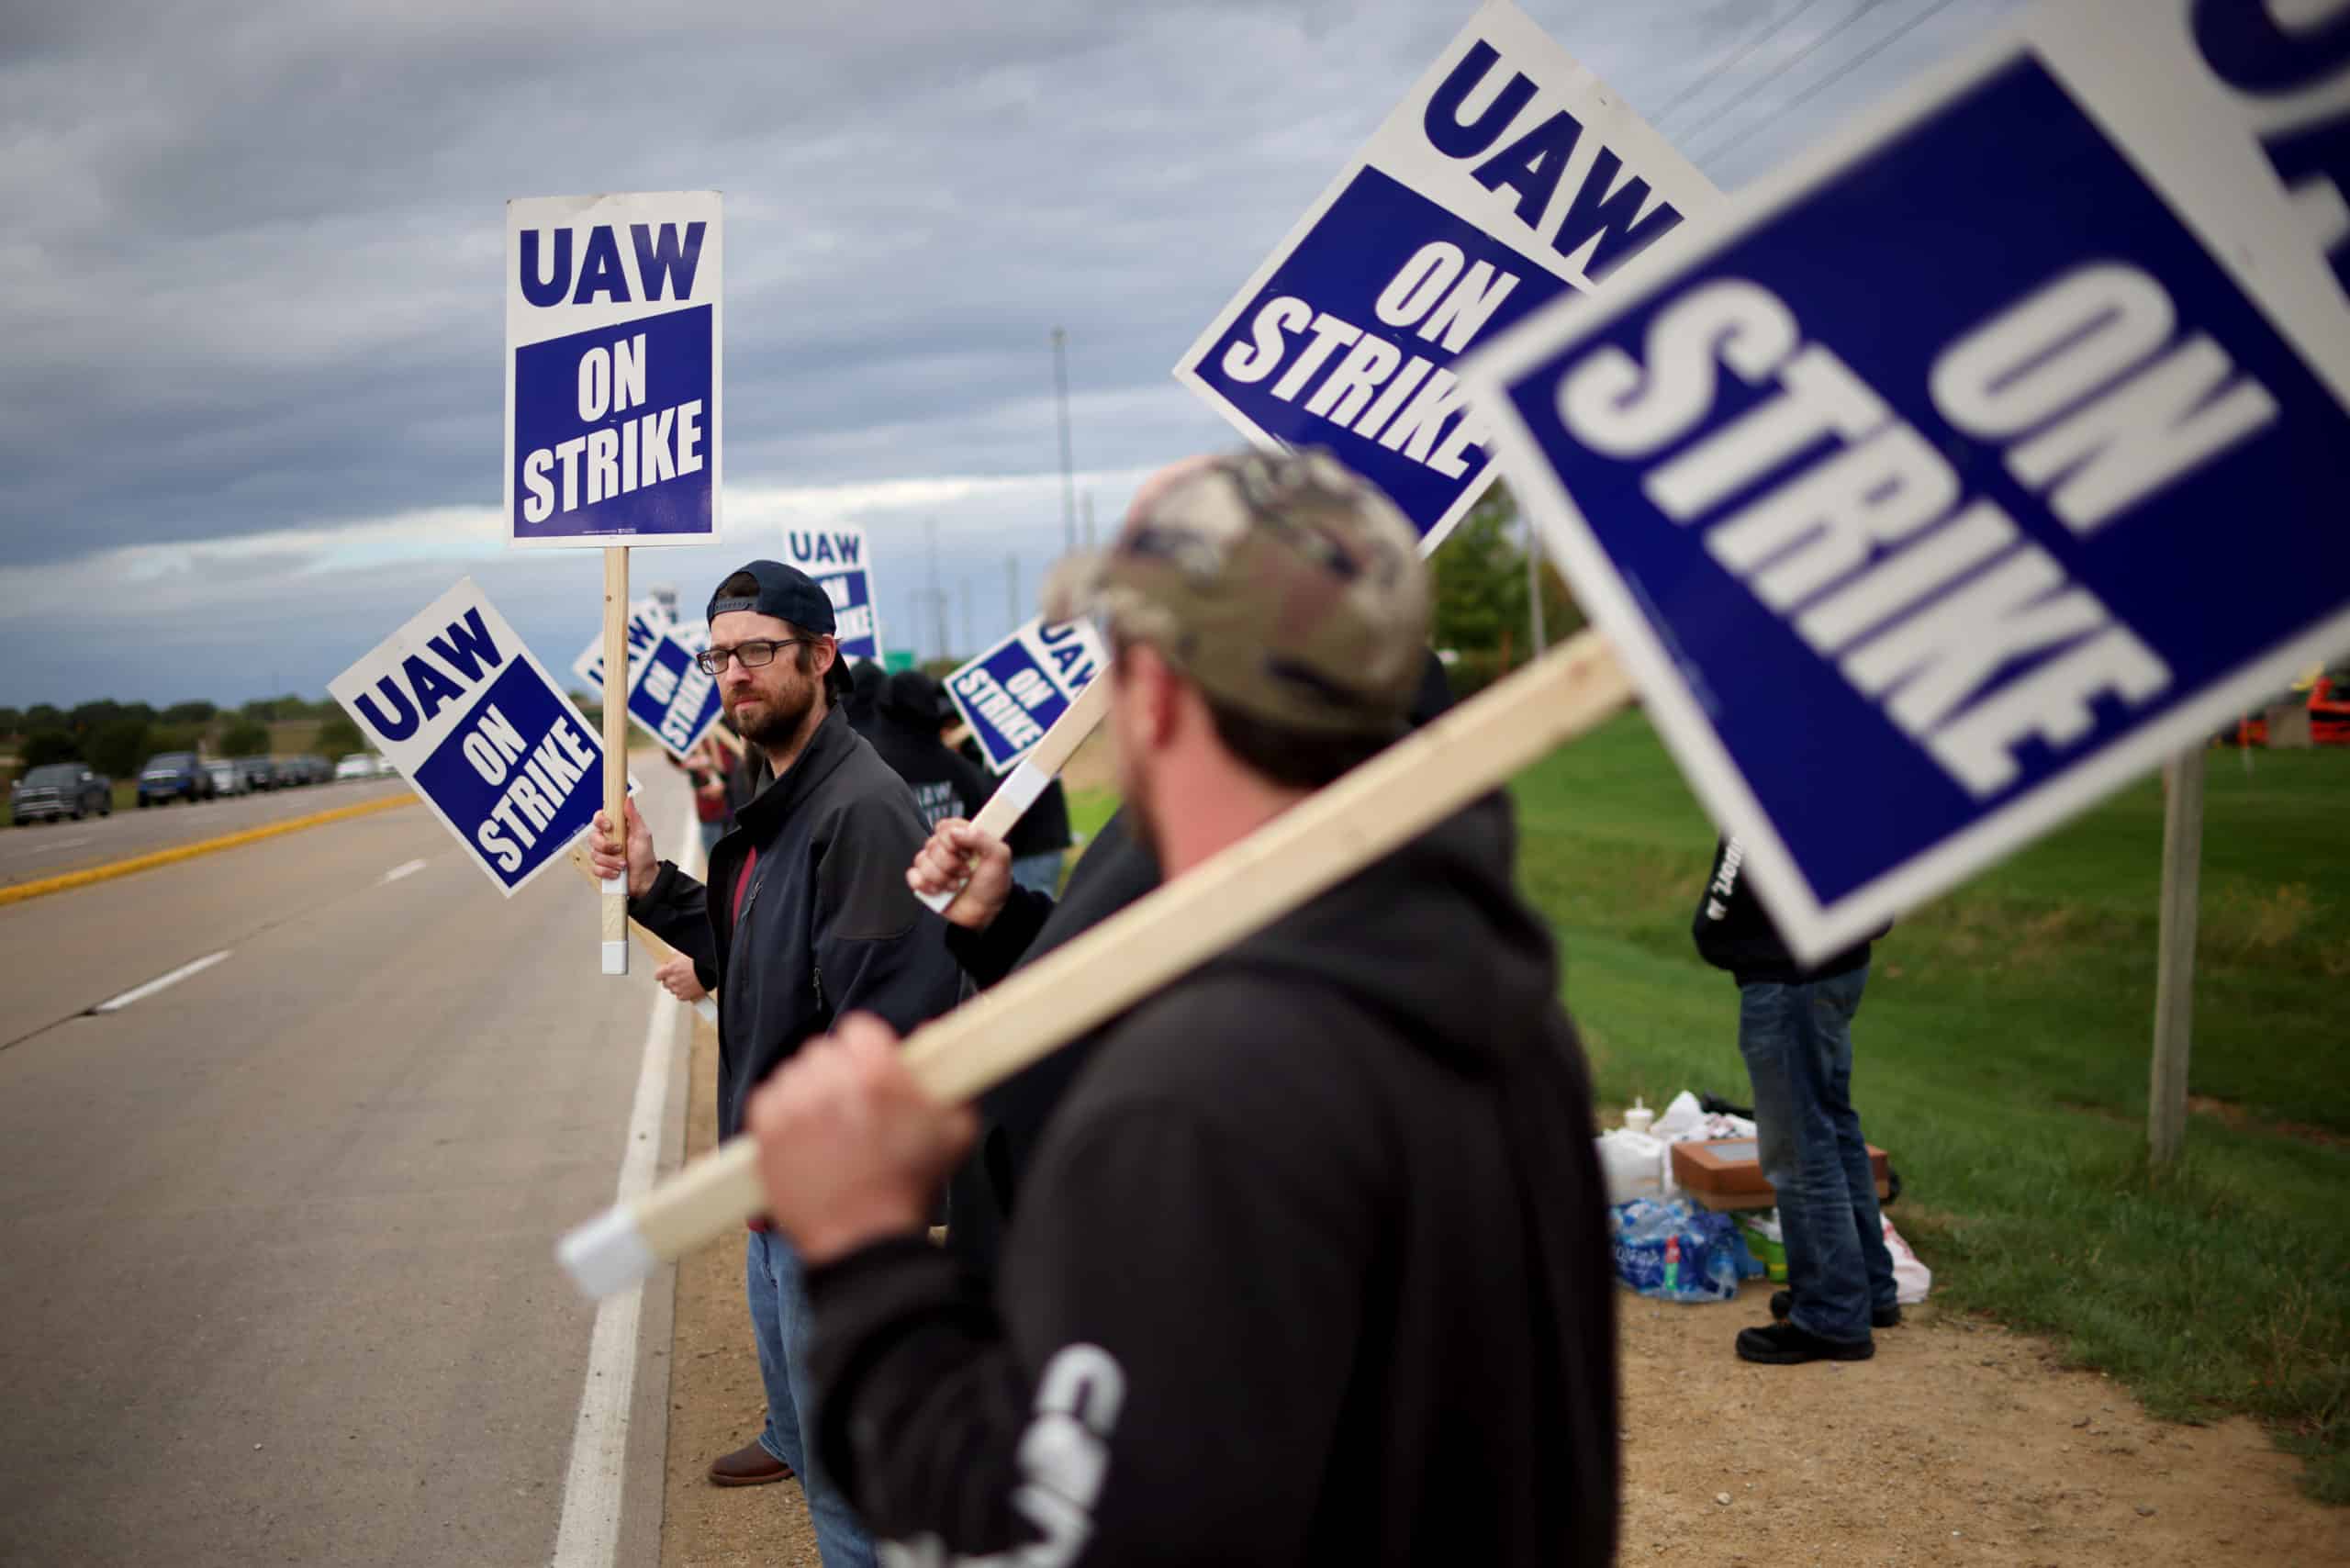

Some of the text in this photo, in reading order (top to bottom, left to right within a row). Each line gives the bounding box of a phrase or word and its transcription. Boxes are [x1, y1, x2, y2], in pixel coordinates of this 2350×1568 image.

[1424, 39, 1685, 286] UAW
[520, 221, 707, 308] UAW
[1374, 241, 1521, 355] ON
[578, 333, 646, 422] ON
[1222, 296, 1492, 480] STRIKE
[1929, 260, 2280, 535] ON
[523, 398, 703, 523] STRIKE
[790, 531, 859, 565] UAW
[1556, 277, 2173, 799] STRIKE
[353, 606, 503, 742] UAW
[956, 667, 1045, 749] STRIKE
[1005, 667, 1055, 711] ON
[463, 703, 528, 787] ON
[477, 715, 596, 873] STRIKE
